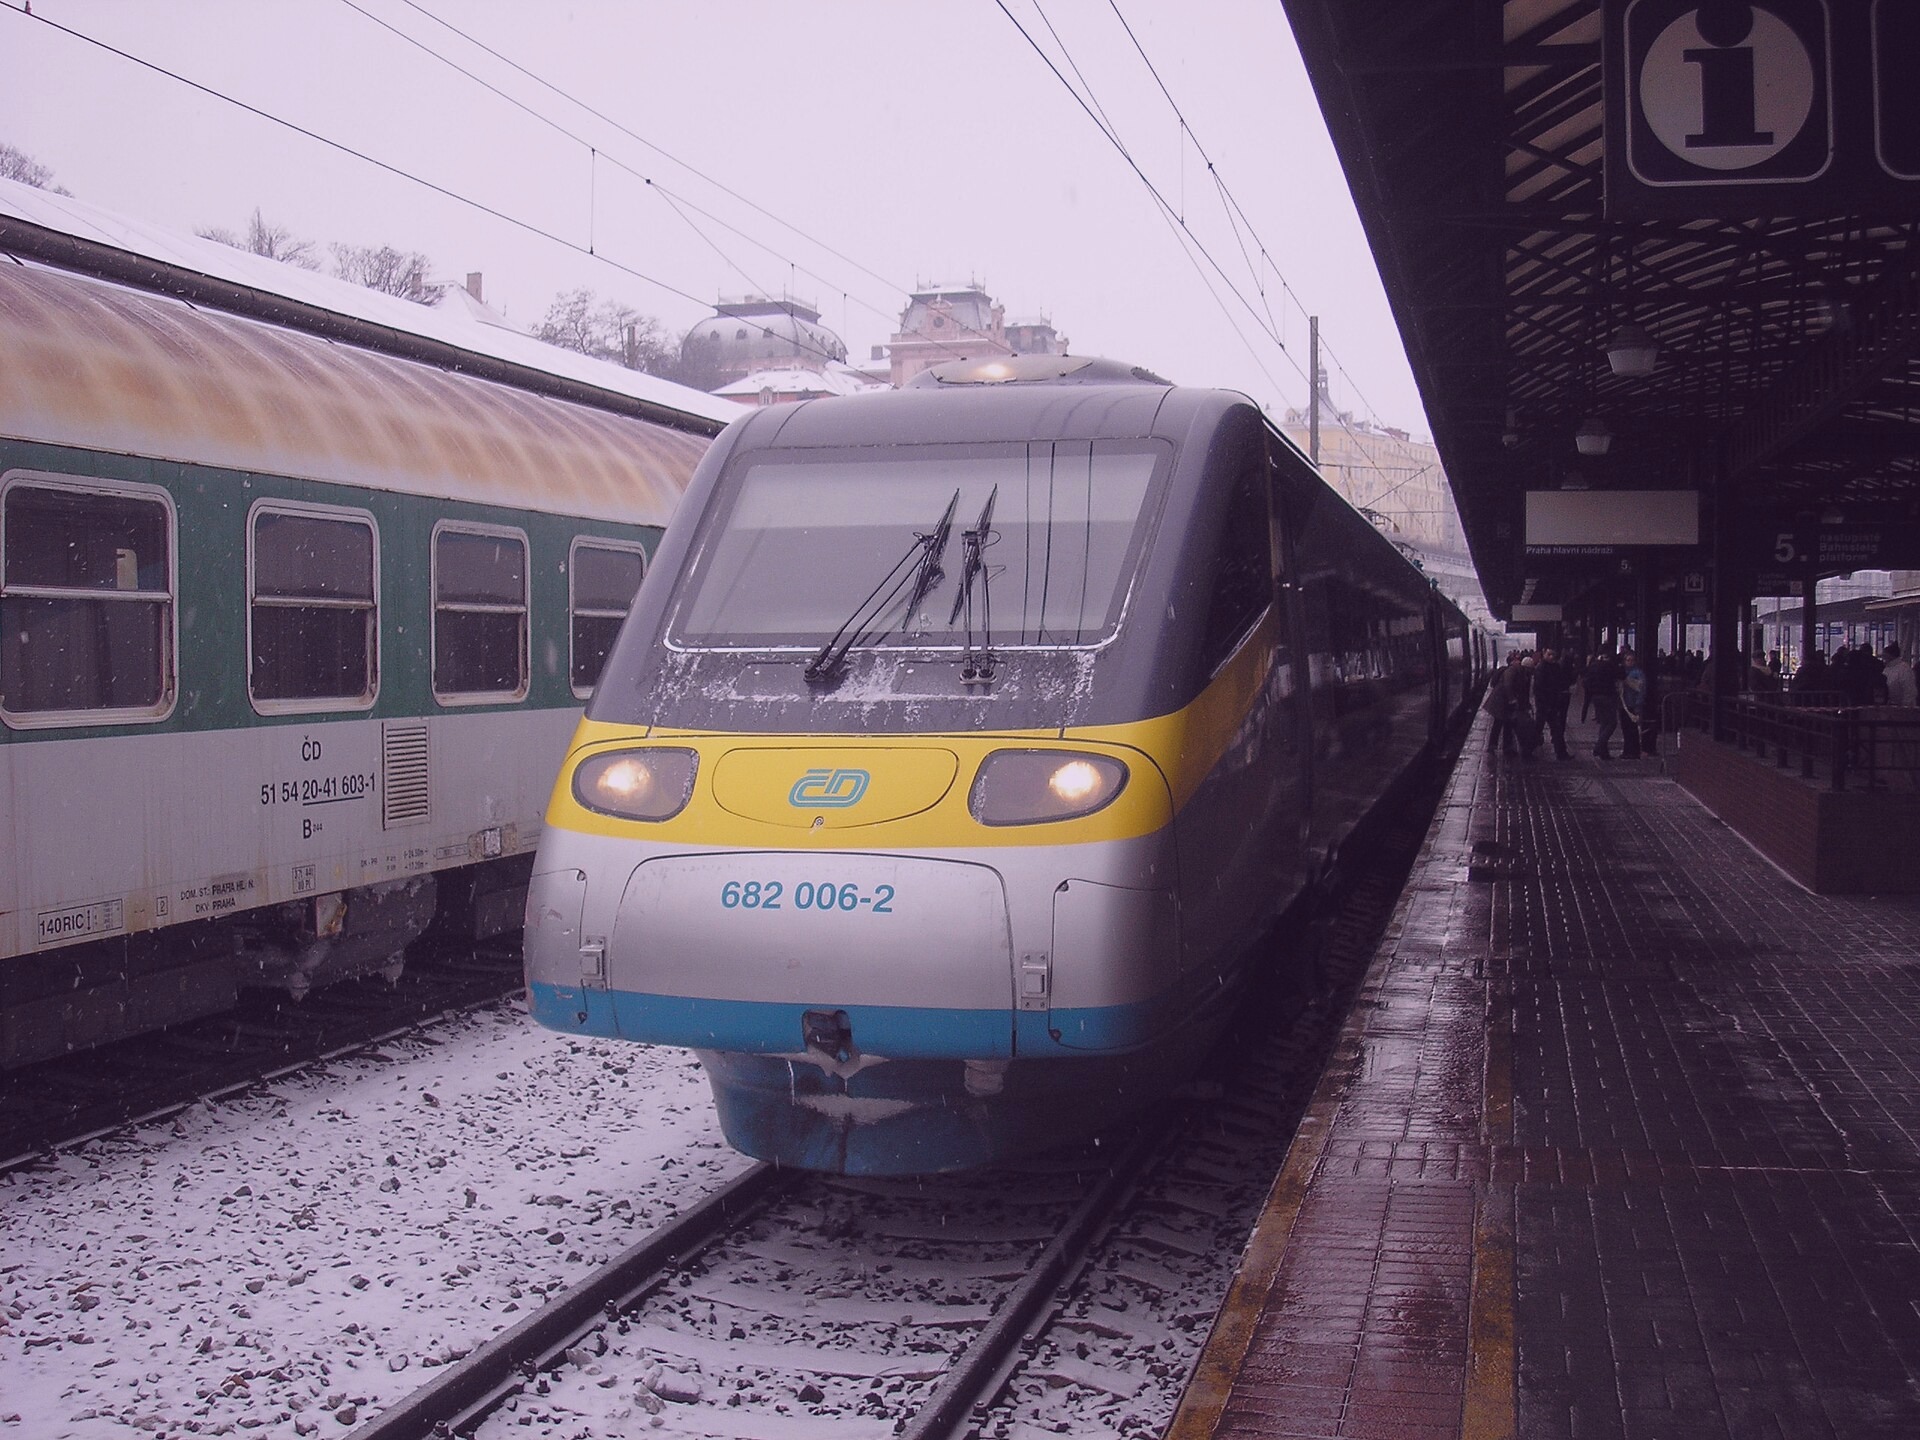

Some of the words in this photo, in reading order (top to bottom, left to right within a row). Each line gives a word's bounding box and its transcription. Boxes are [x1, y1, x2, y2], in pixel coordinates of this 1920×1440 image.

[1525, 546, 1551, 555] Praha
[1775, 533, 1808, 563] 5.
[1819, 543, 1878, 554] Bahnsteig
[1819, 552, 1868, 563] platform
[302, 735, 321, 761] ČD
[261, 784, 276, 805] 51
[282, 781, 298, 802] 54
[303, 777, 337, 800] 20-41
[342, 772, 375, 795] 603-1
[212, 896, 236, 911] PRAHA
[721, 881, 784, 909] 682
[794, 882, 895, 913] 006-2
